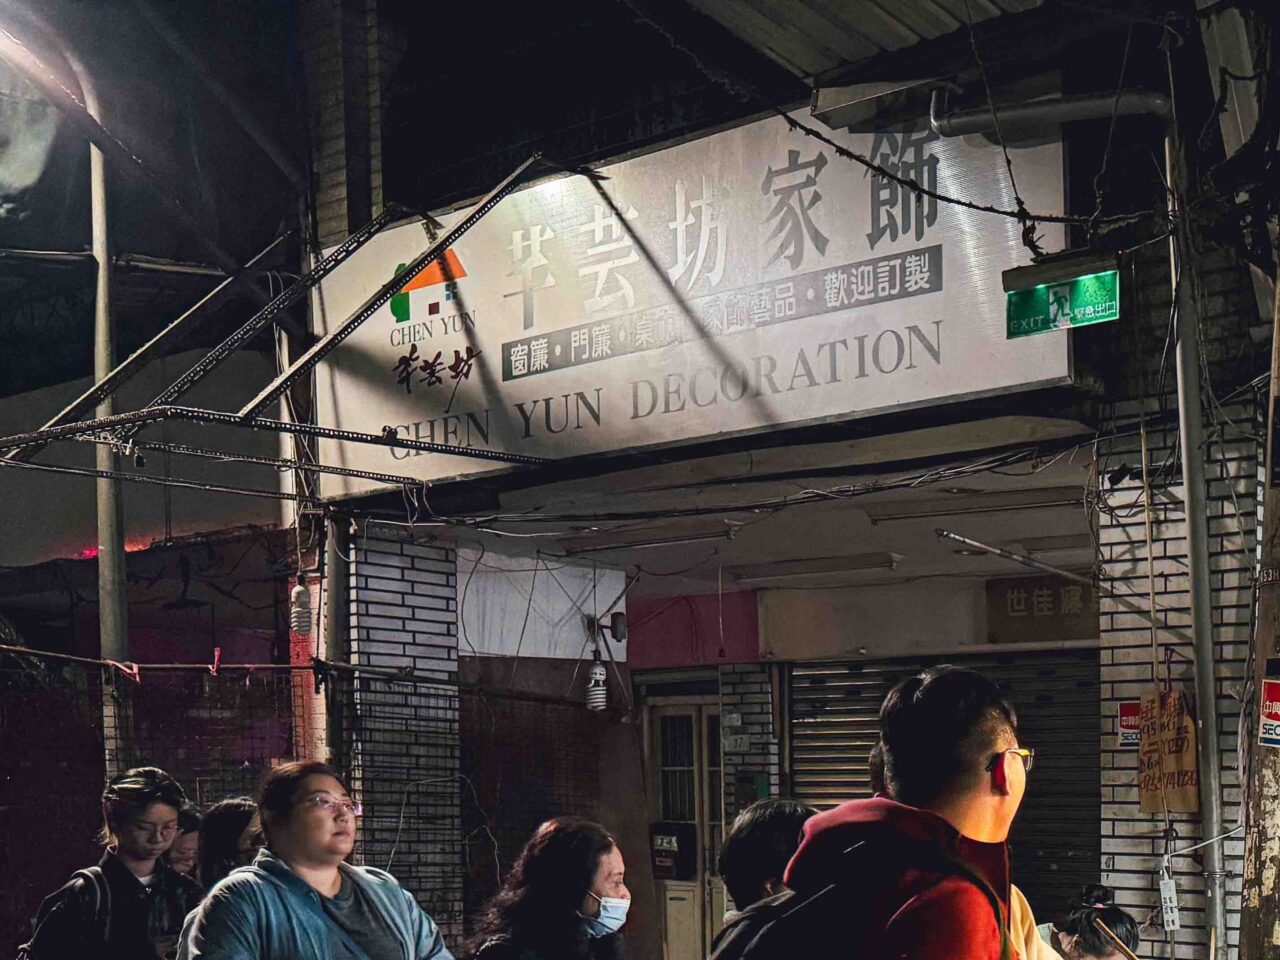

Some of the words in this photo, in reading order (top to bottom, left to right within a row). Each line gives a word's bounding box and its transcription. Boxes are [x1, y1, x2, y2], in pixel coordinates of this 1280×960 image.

[390, 319, 434, 347] CHEN
[439, 310, 477, 335] YUN
[1011, 315, 1045, 331] EXIT
[390, 409, 490, 461] CHEN
[515, 387, 603, 438] YUN
[629, 319, 943, 421] DECORATION
